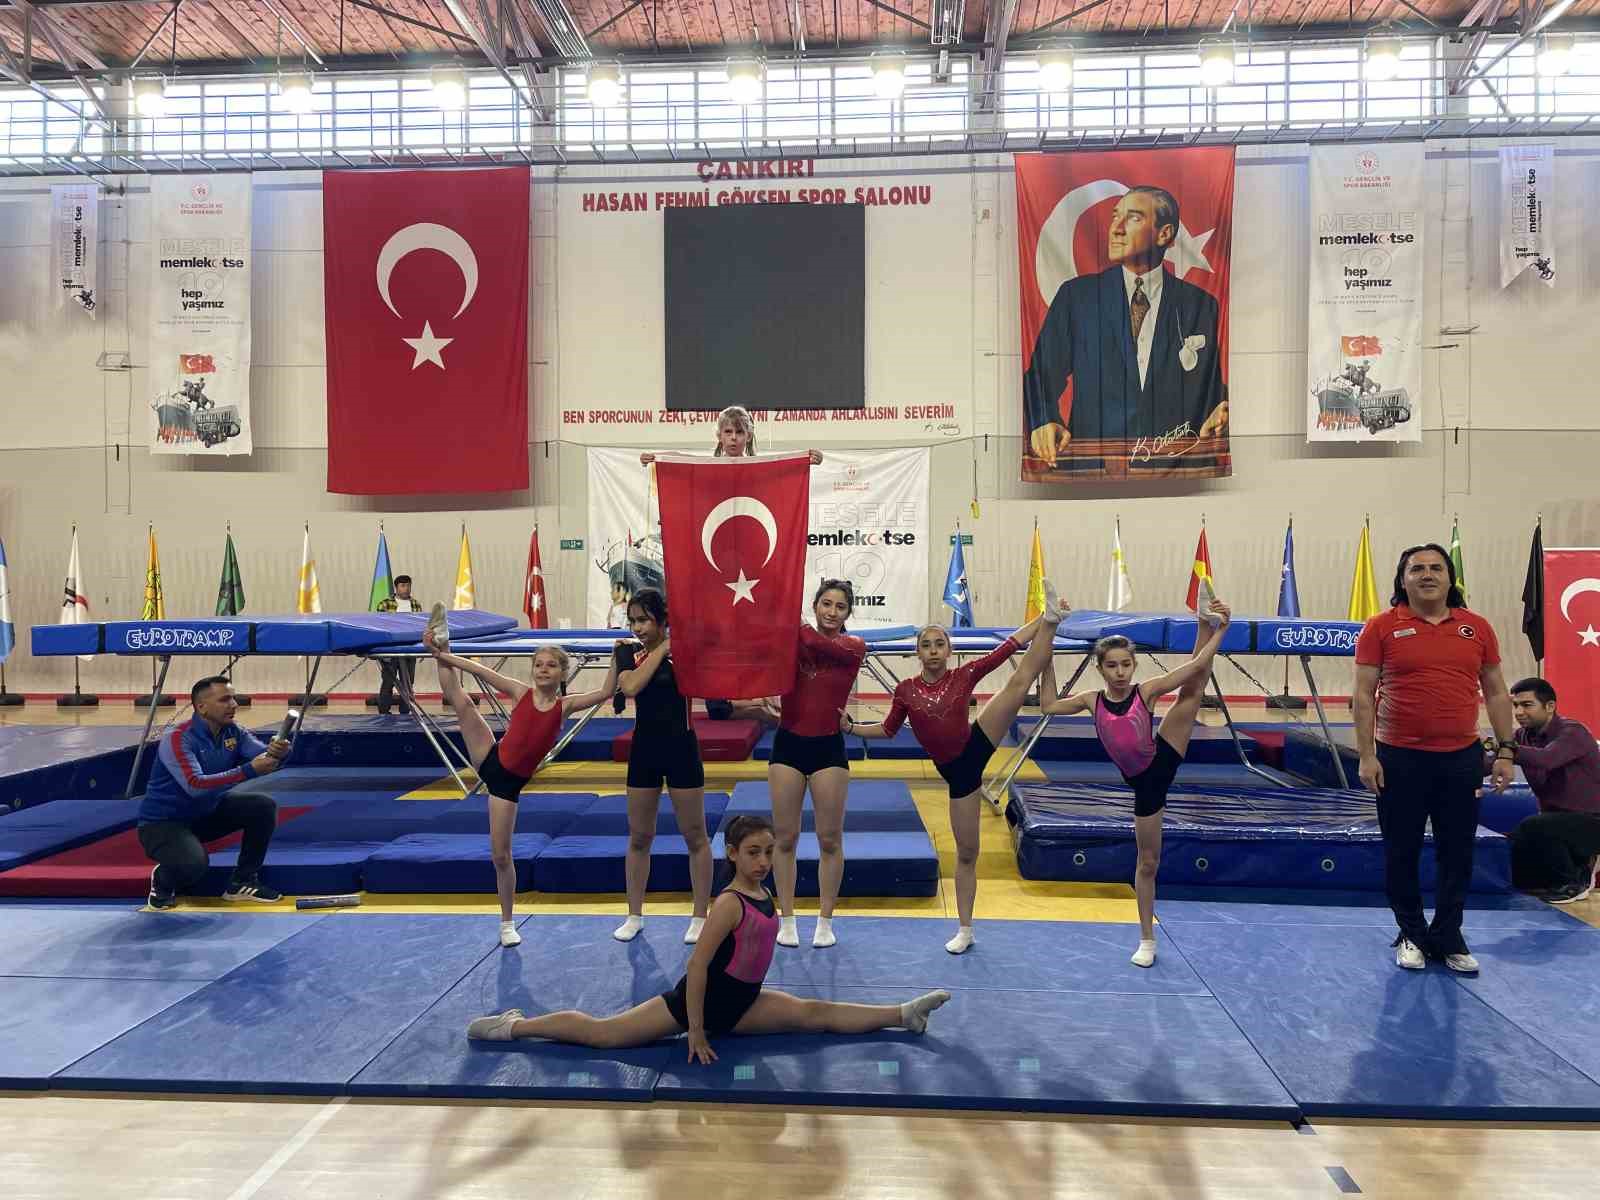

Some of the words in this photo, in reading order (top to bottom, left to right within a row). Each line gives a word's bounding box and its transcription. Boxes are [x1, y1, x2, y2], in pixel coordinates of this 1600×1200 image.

[697, 160, 814, 183] ÇANKIRI
[582, 192, 648, 212] HASAN
[655, 188, 710, 210] FEHMİ
[798, 188, 846, 204] SPOR
[854, 185, 931, 206] SALONU
[1344, 266, 1368, 279] hep
[181, 289, 203, 300] hep
[1345, 279, 1392, 291] yaşımız
[182, 300, 224, 311] yaşımız
[563, 410, 585, 423] BEN
[589, 409, 653, 423] SPORCUNUN
[751, 410, 768, 422] YNI
[774, 409, 827, 422] ZAMANDA
[831, 406, 898, 421] AHLAKLISINI
[904, 403, 955, 420] SEVERİM
[127, 628, 233, 648] EUROTRAMP
[1277, 627, 1360, 649] EUROTRA
